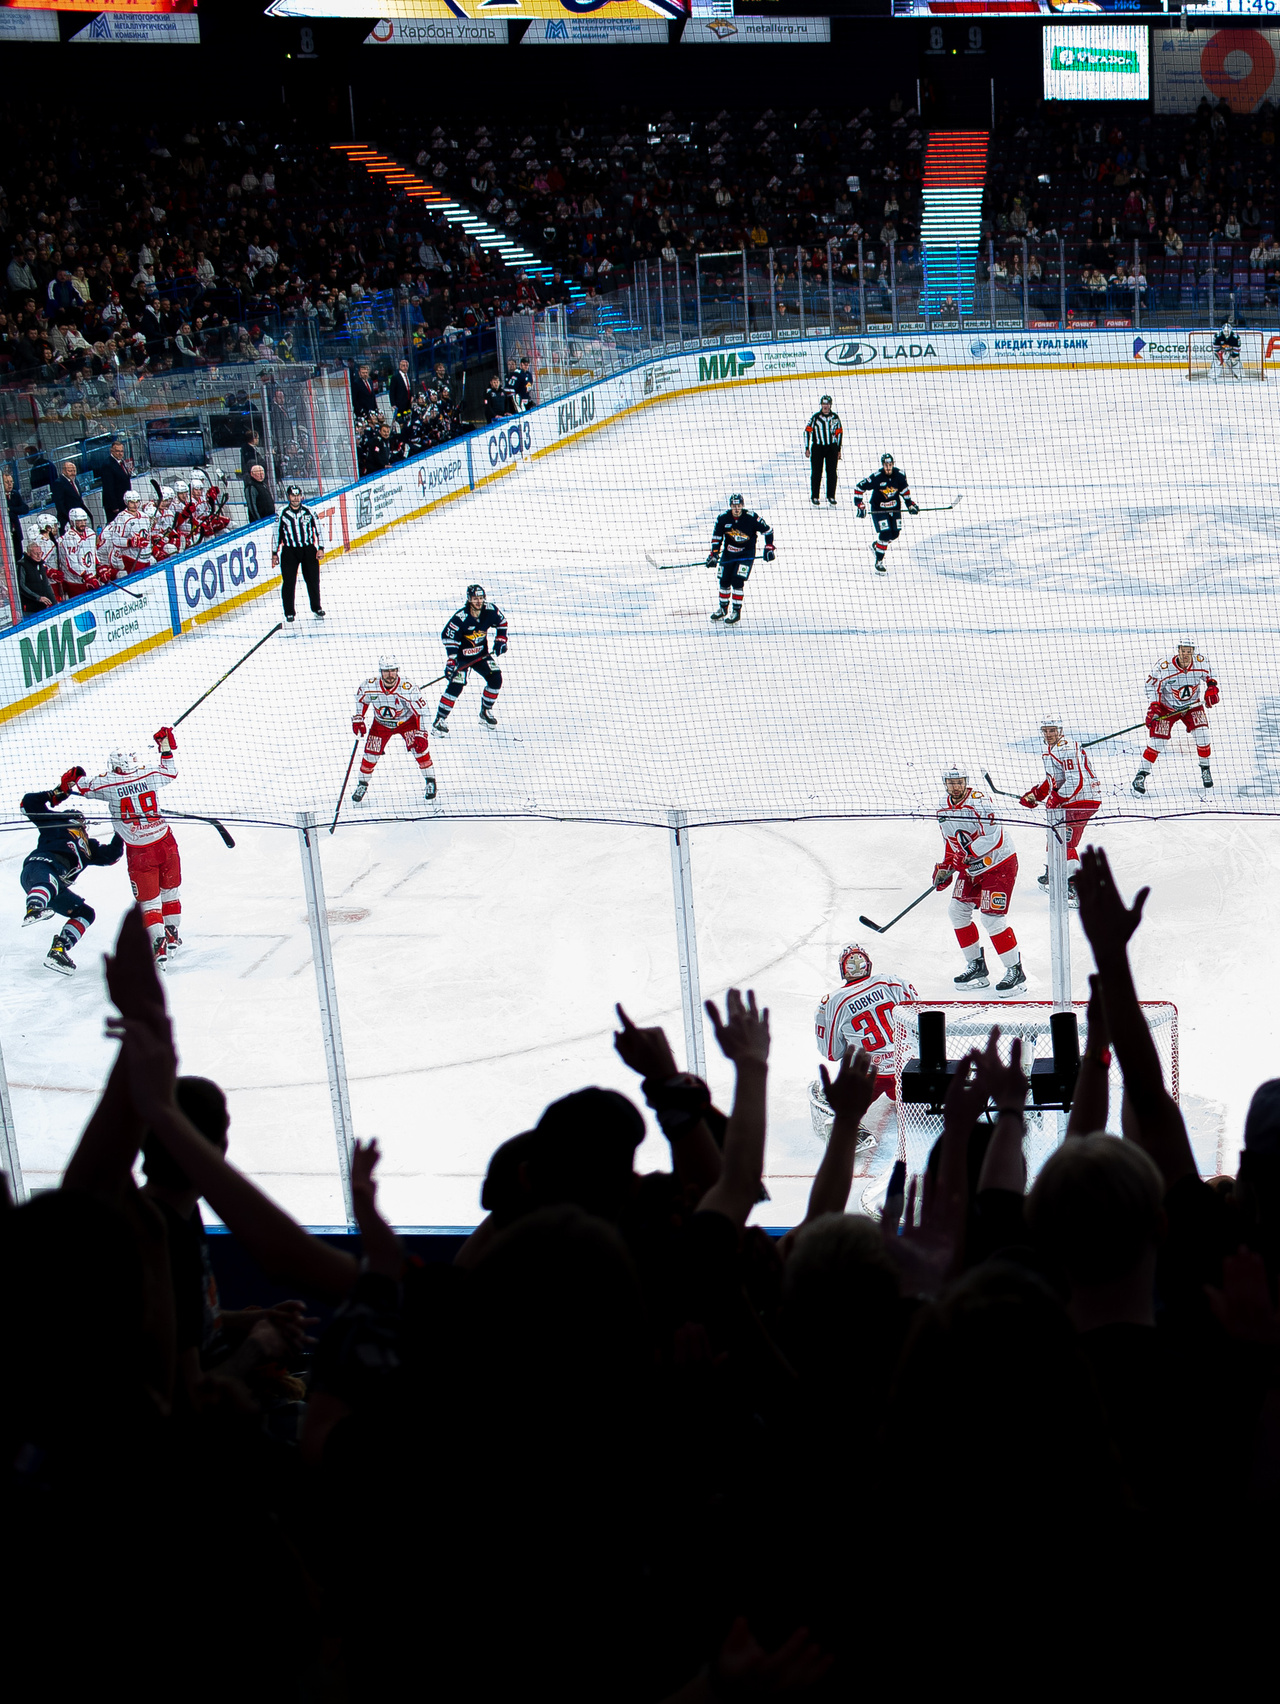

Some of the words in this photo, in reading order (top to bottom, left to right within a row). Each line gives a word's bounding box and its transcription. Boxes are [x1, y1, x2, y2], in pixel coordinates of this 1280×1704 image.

[1115, 0, 1140, 9] MMG
[113, 13, 170, 21] МАГНИТОГОРСКИЙ
[114, 22, 177, 30] МЕТАЛЛУРГИЧЕСКИЙ
[400, 24, 453, 41] Карбон
[456, 24, 495, 40] Уголь
[746, 24, 807, 34] metallurg.ru
[300, 27, 314, 53] 8
[929, 26, 943, 49] 8
[968, 26, 982, 49] 9
[883, 343, 937, 359] LADA
[994, 339, 1034, 351] КРЕДИТ
[1037, 339, 1061, 349] УРАЛ
[1063, 339, 1088, 349] БАНК
[1149, 342, 1213, 353] Ростелеко
[699, 351, 756, 381] МИР
[764, 361, 796, 370] система
[558, 391, 595, 435] KHL.RU
[184, 541, 259, 608] согаз
[105, 597, 148, 624] Платёжная
[107, 619, 139, 643] система
[445, 627, 455, 639] 35
[20, 610, 97, 689] МИР
[1146, 674, 1158, 686] 77
[415, 697, 426, 709] 15
[1063, 759, 1074, 771] 18
[117, 782, 149, 797] GURKIN
[120, 790, 162, 827] 49
[848, 989, 884, 1014] BOBKOV
[851, 1001, 895, 1052] 30
